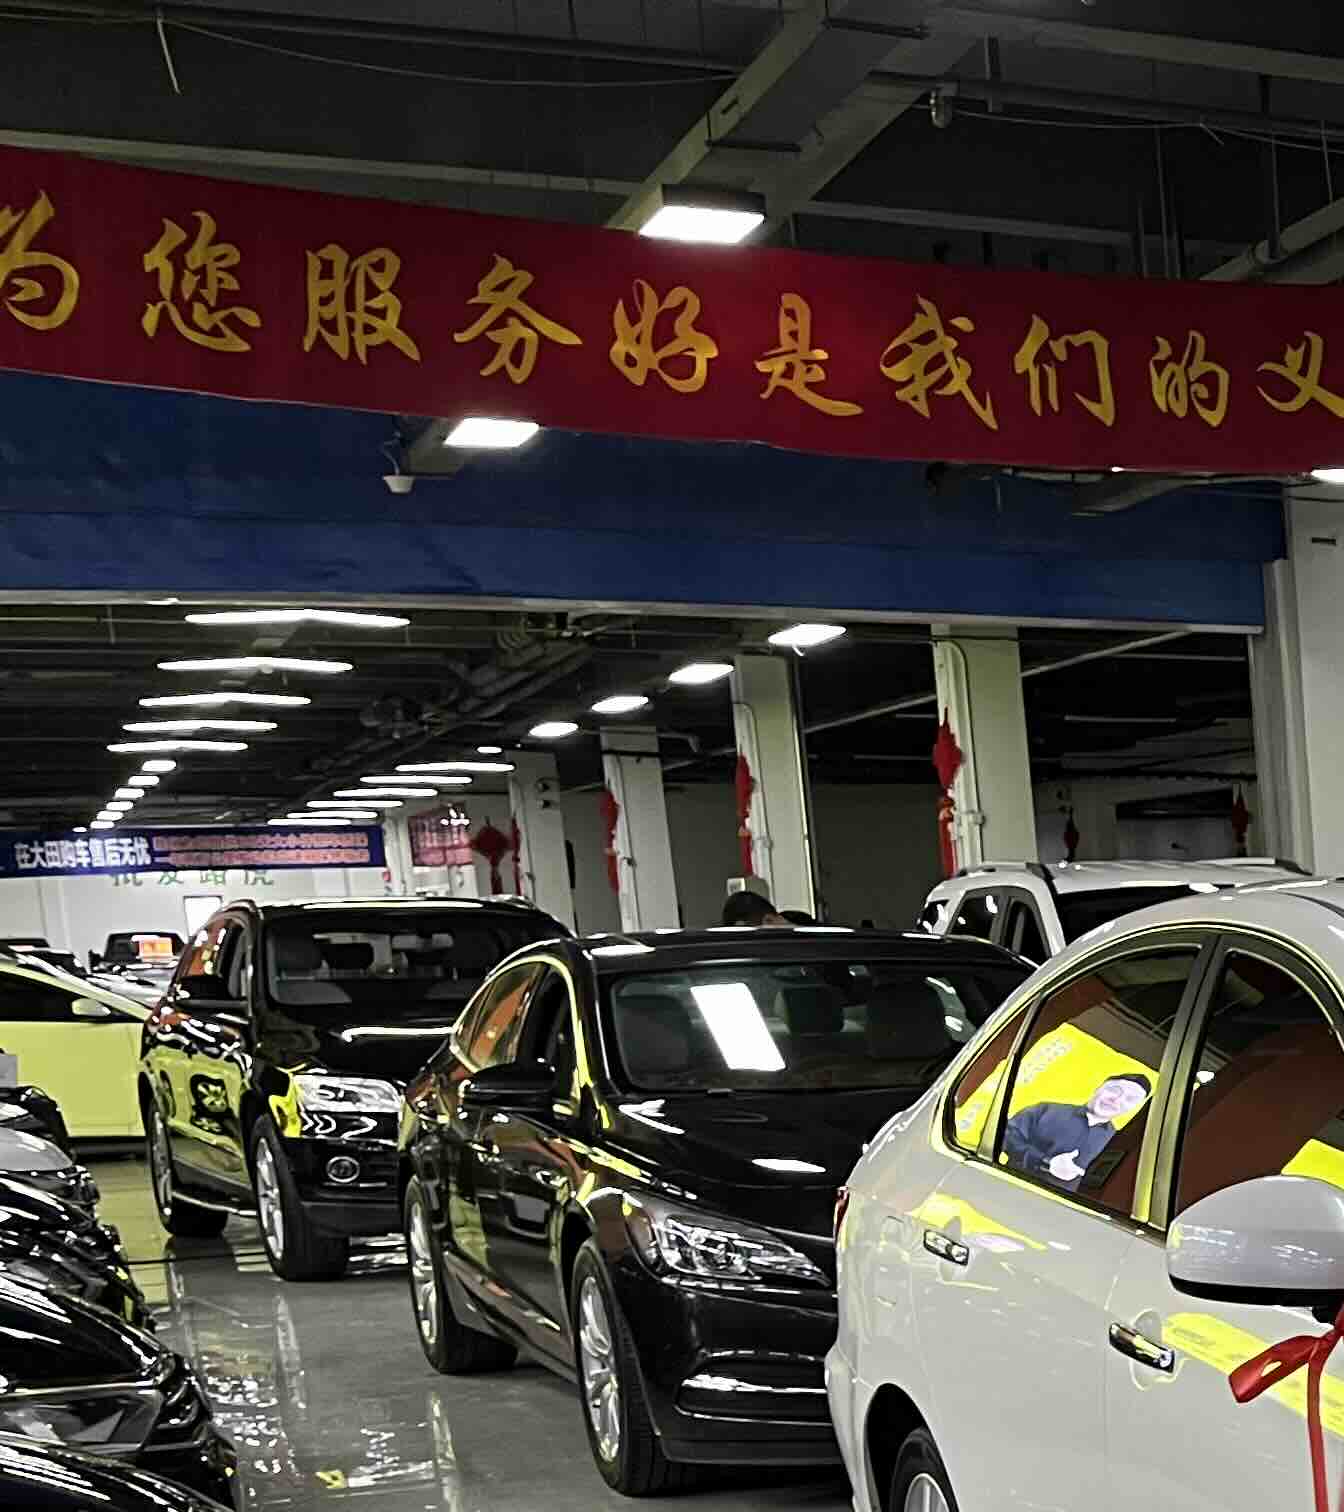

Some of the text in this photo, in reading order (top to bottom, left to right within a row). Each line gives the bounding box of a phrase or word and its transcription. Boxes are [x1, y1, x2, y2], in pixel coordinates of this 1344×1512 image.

[14, 837, 151, 870] 在大田购车售后无忧
